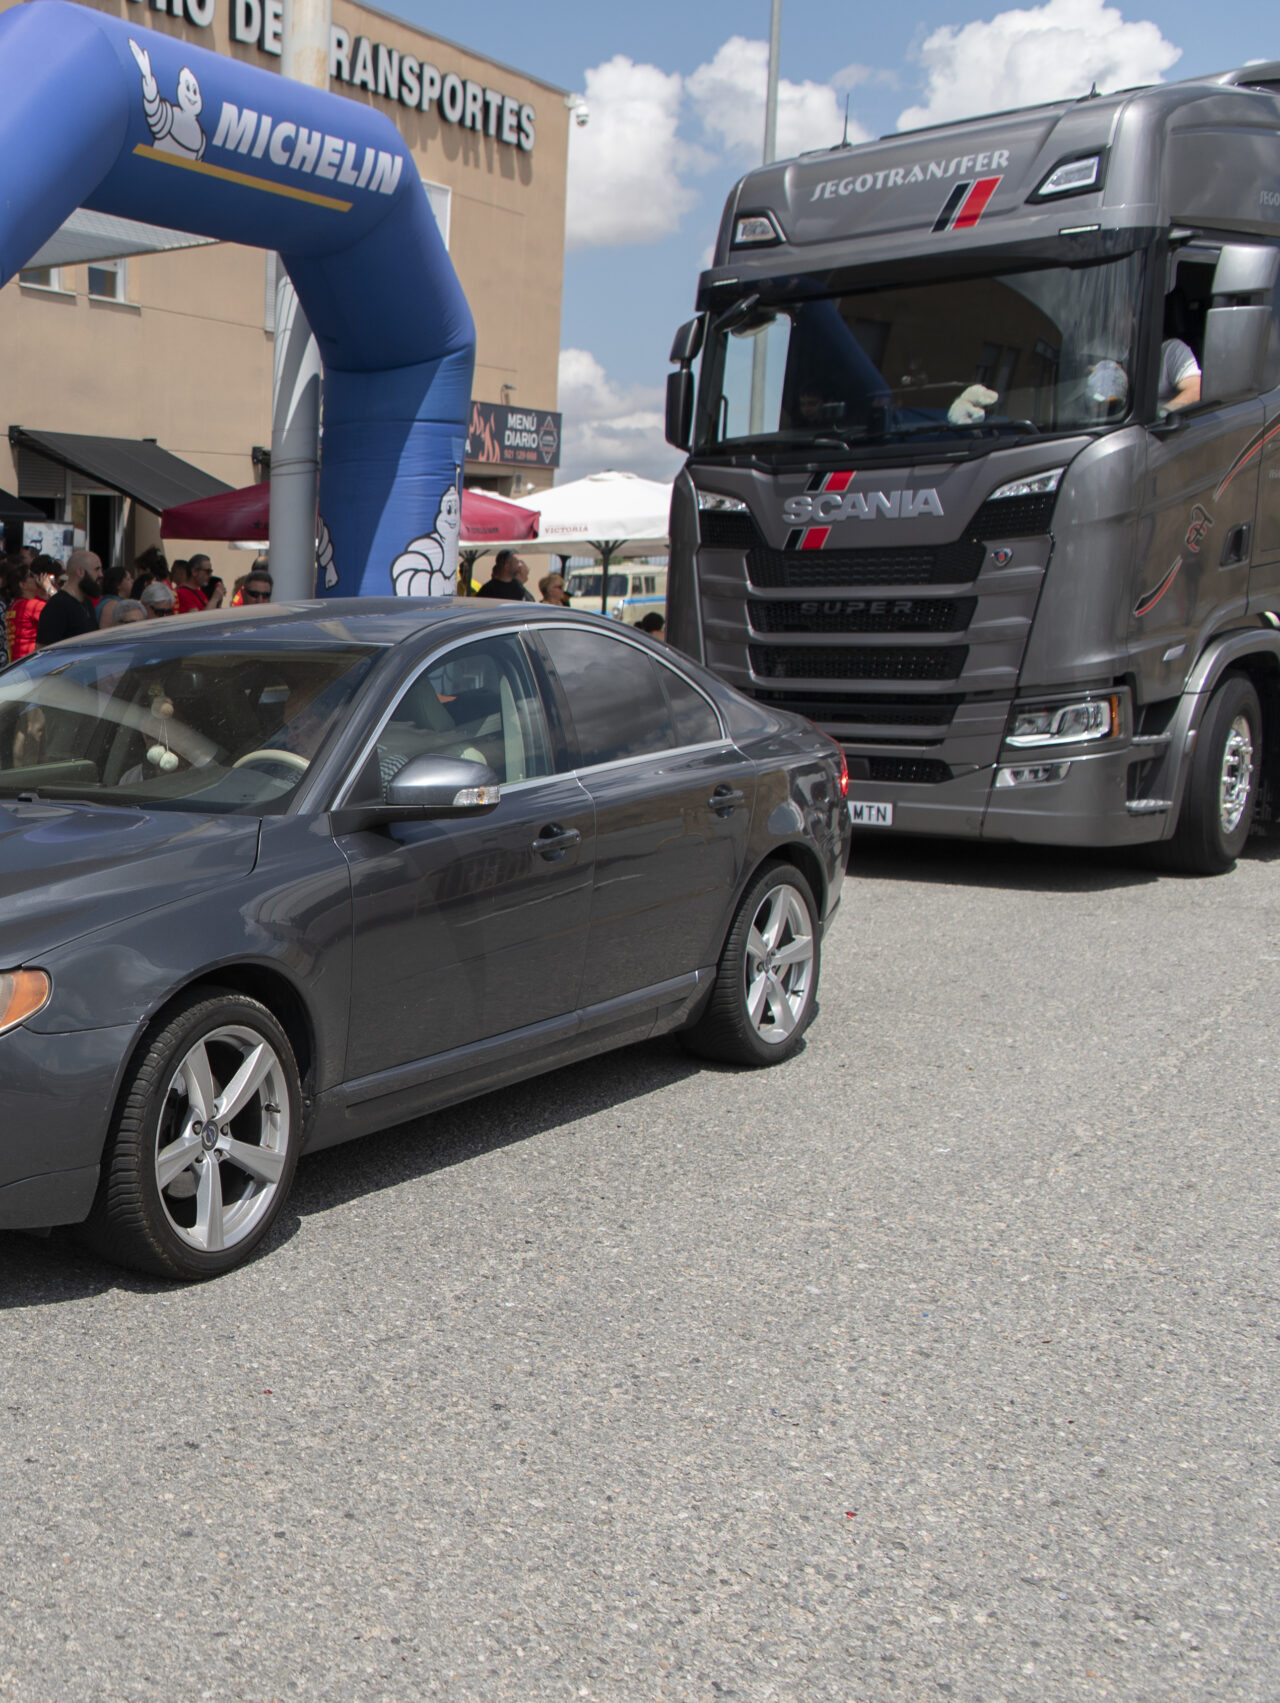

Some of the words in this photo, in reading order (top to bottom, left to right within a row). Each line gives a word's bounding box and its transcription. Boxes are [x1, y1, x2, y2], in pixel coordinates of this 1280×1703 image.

[231, 0, 283, 55] DE
[329, 24, 536, 151] RANSPORTES
[212, 102, 403, 195] MICHELIN
[810, 149, 1010, 202] SEGOTRANSFER
[507, 412, 537, 431] MENÚ
[504, 431, 538, 449] DIARIO
[782, 488, 945, 524] SCANIA
[544, 525, 589, 534] VICTORIA
[800, 601, 913, 615] SUPER
[853, 804, 887, 822] MTN
